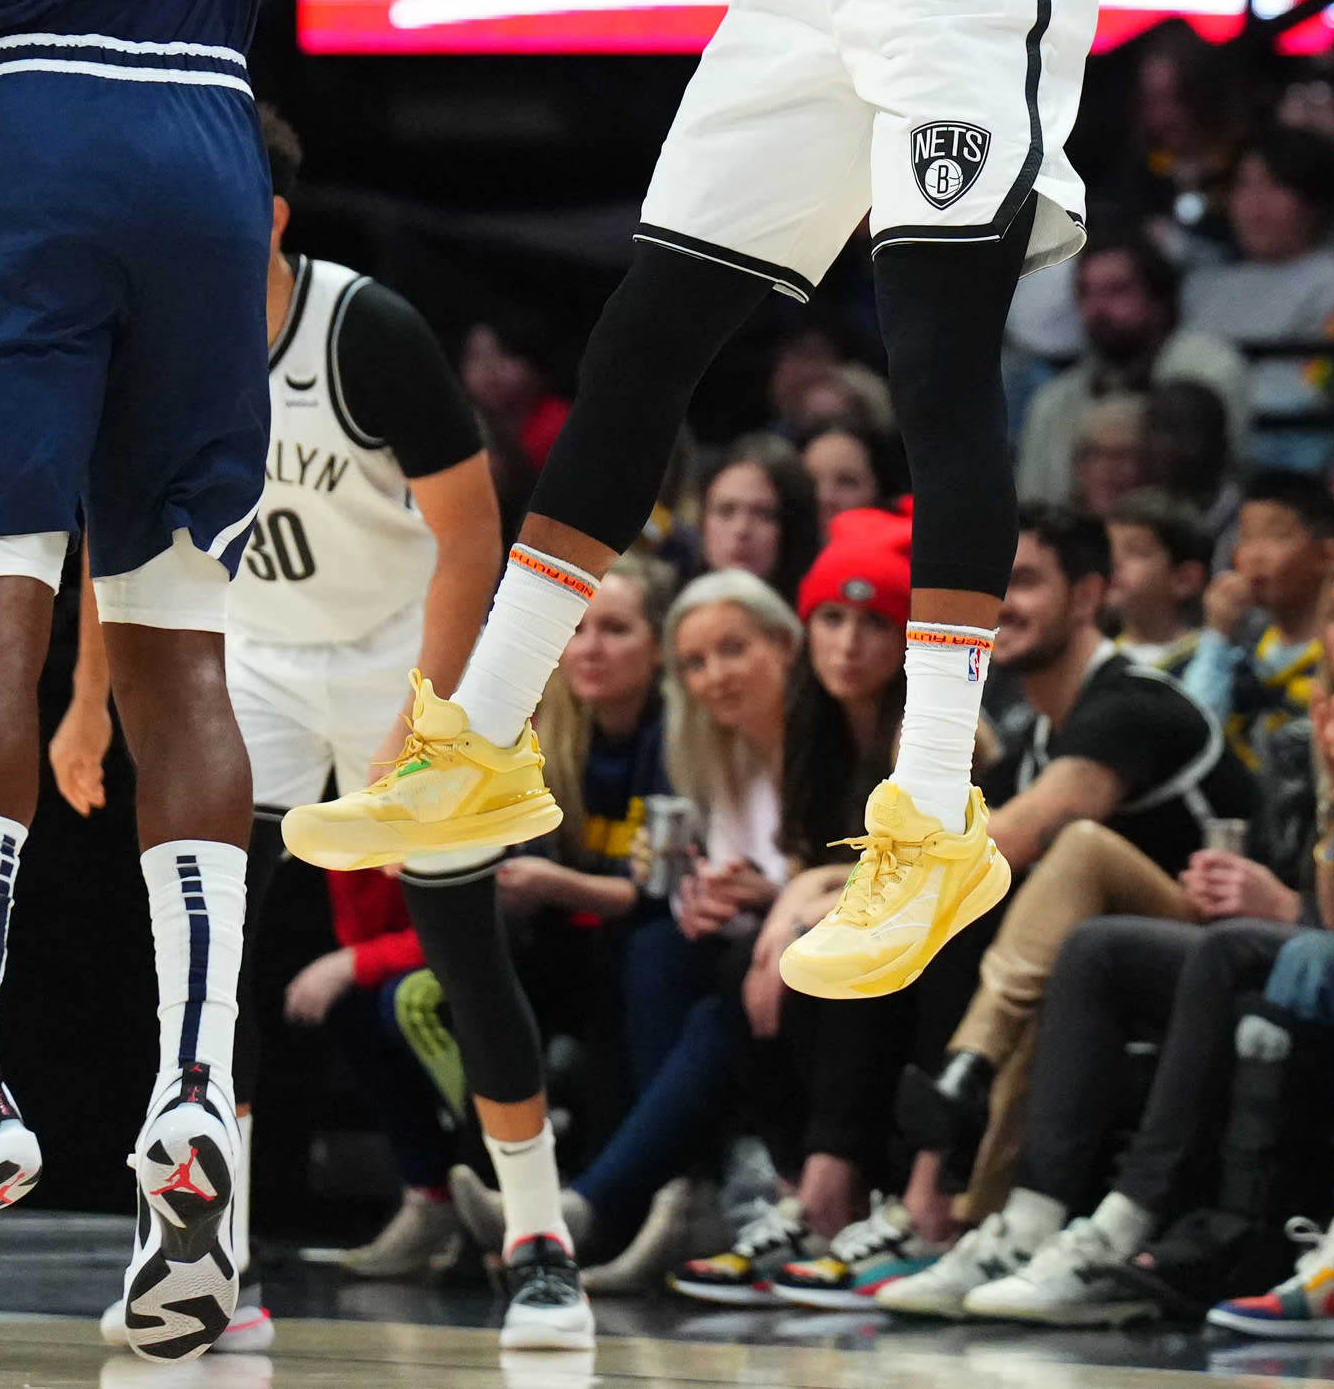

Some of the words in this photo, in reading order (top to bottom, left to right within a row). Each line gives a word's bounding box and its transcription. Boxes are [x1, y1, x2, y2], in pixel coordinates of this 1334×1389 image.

[915, 126, 983, 163] NETS
[937, 165, 949, 193] B
[247, 509, 316, 581] 30
